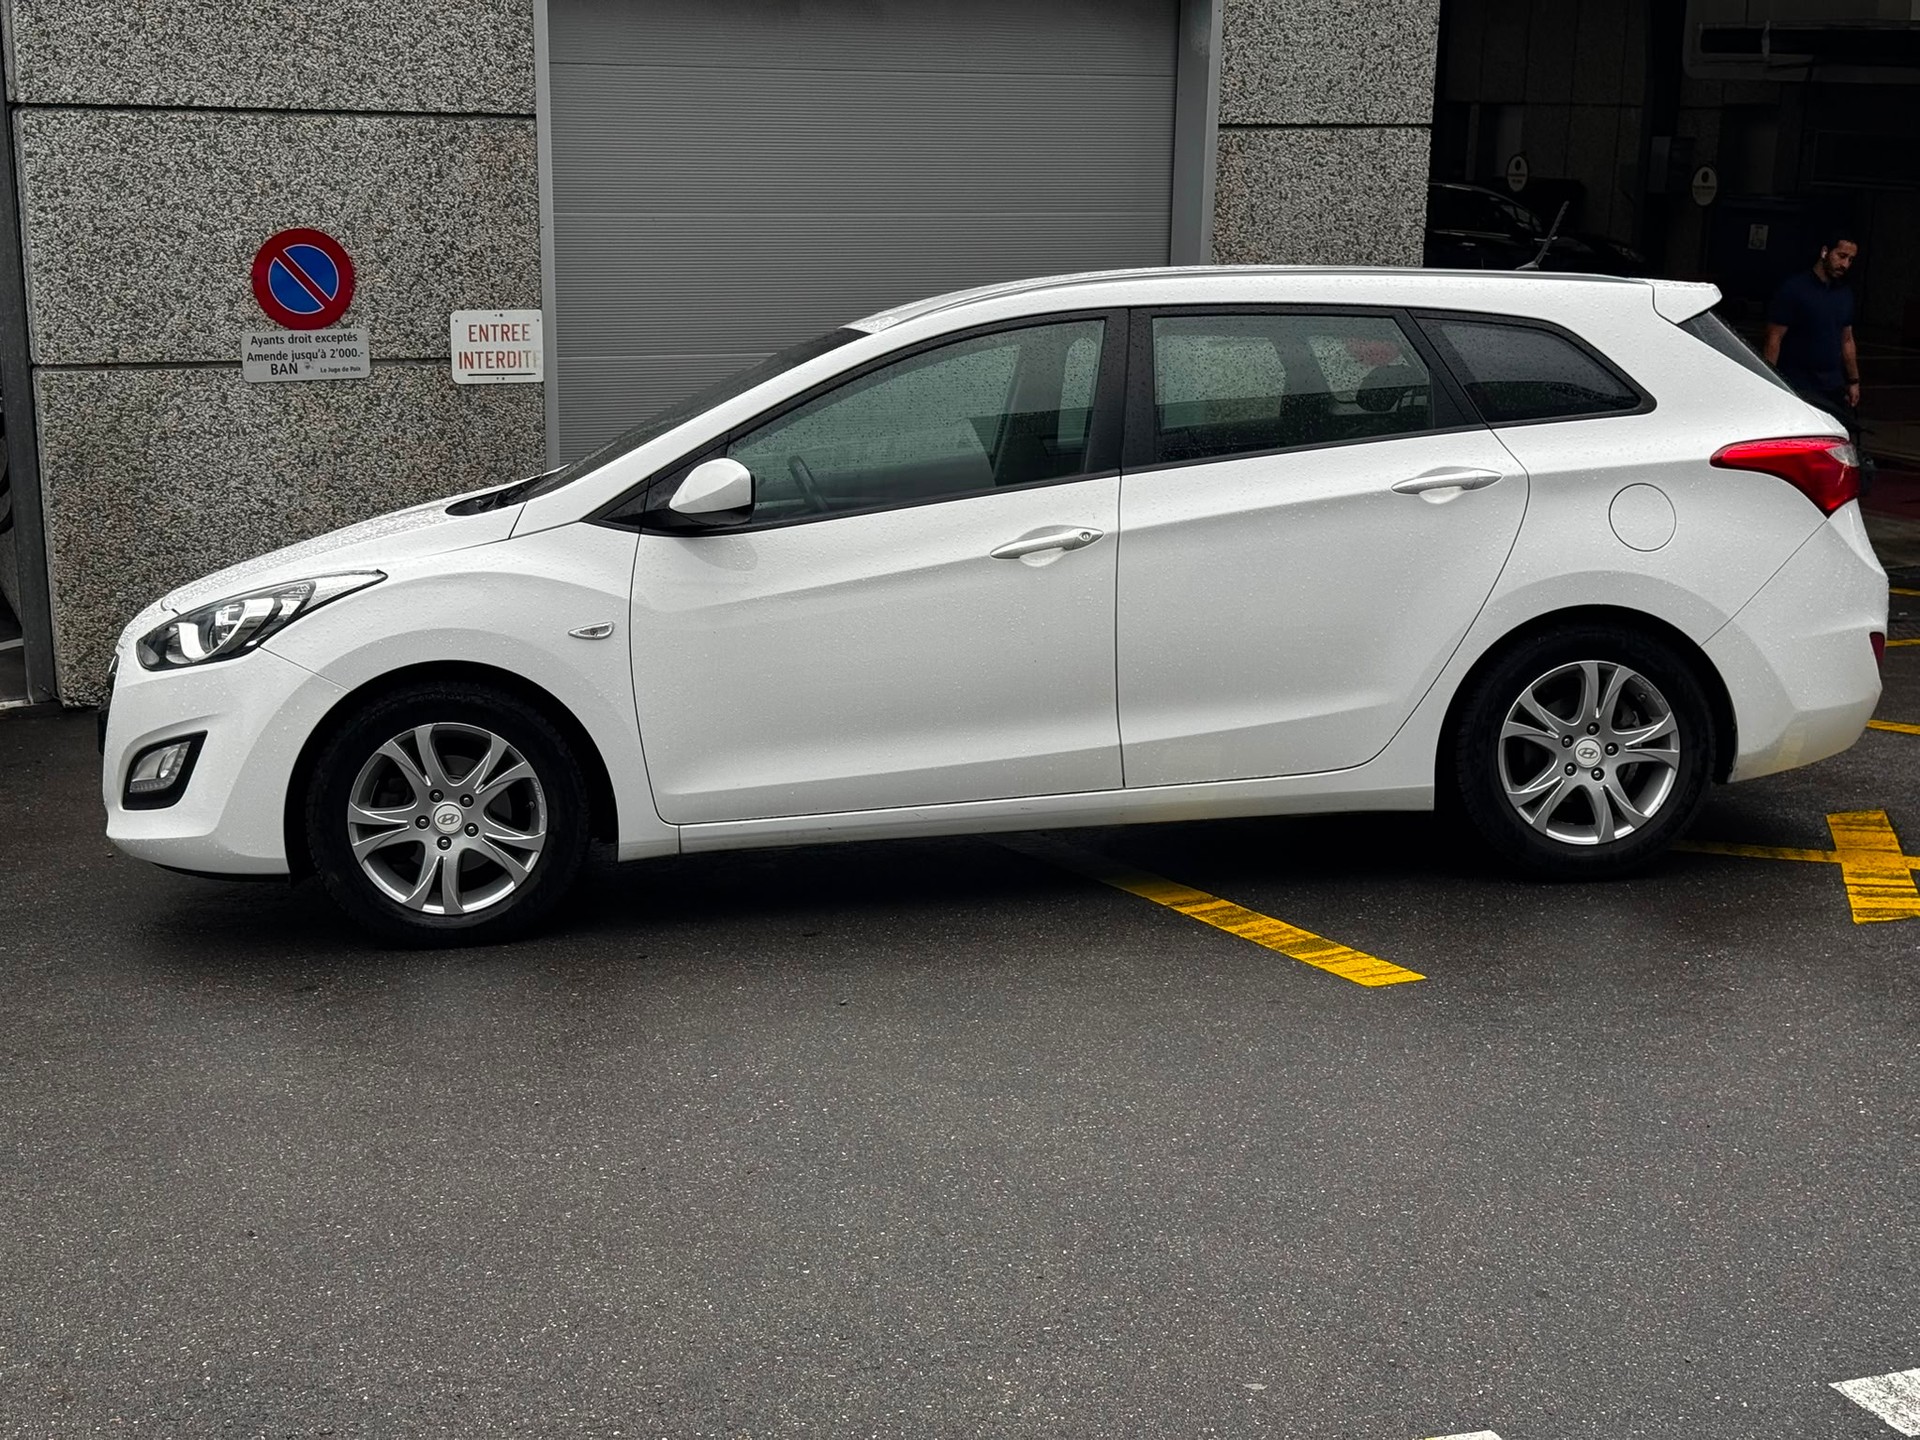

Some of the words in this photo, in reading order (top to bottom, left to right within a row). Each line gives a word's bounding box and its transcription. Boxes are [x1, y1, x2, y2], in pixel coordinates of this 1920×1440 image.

[468, 323, 531, 342] ENTREE
[250, 335, 285, 348] Ayants
[288, 334, 312, 344] droit
[315, 332, 358, 345] exceptés
[246, 351, 289, 362] Amende
[270, 363, 298, 375] BAN
